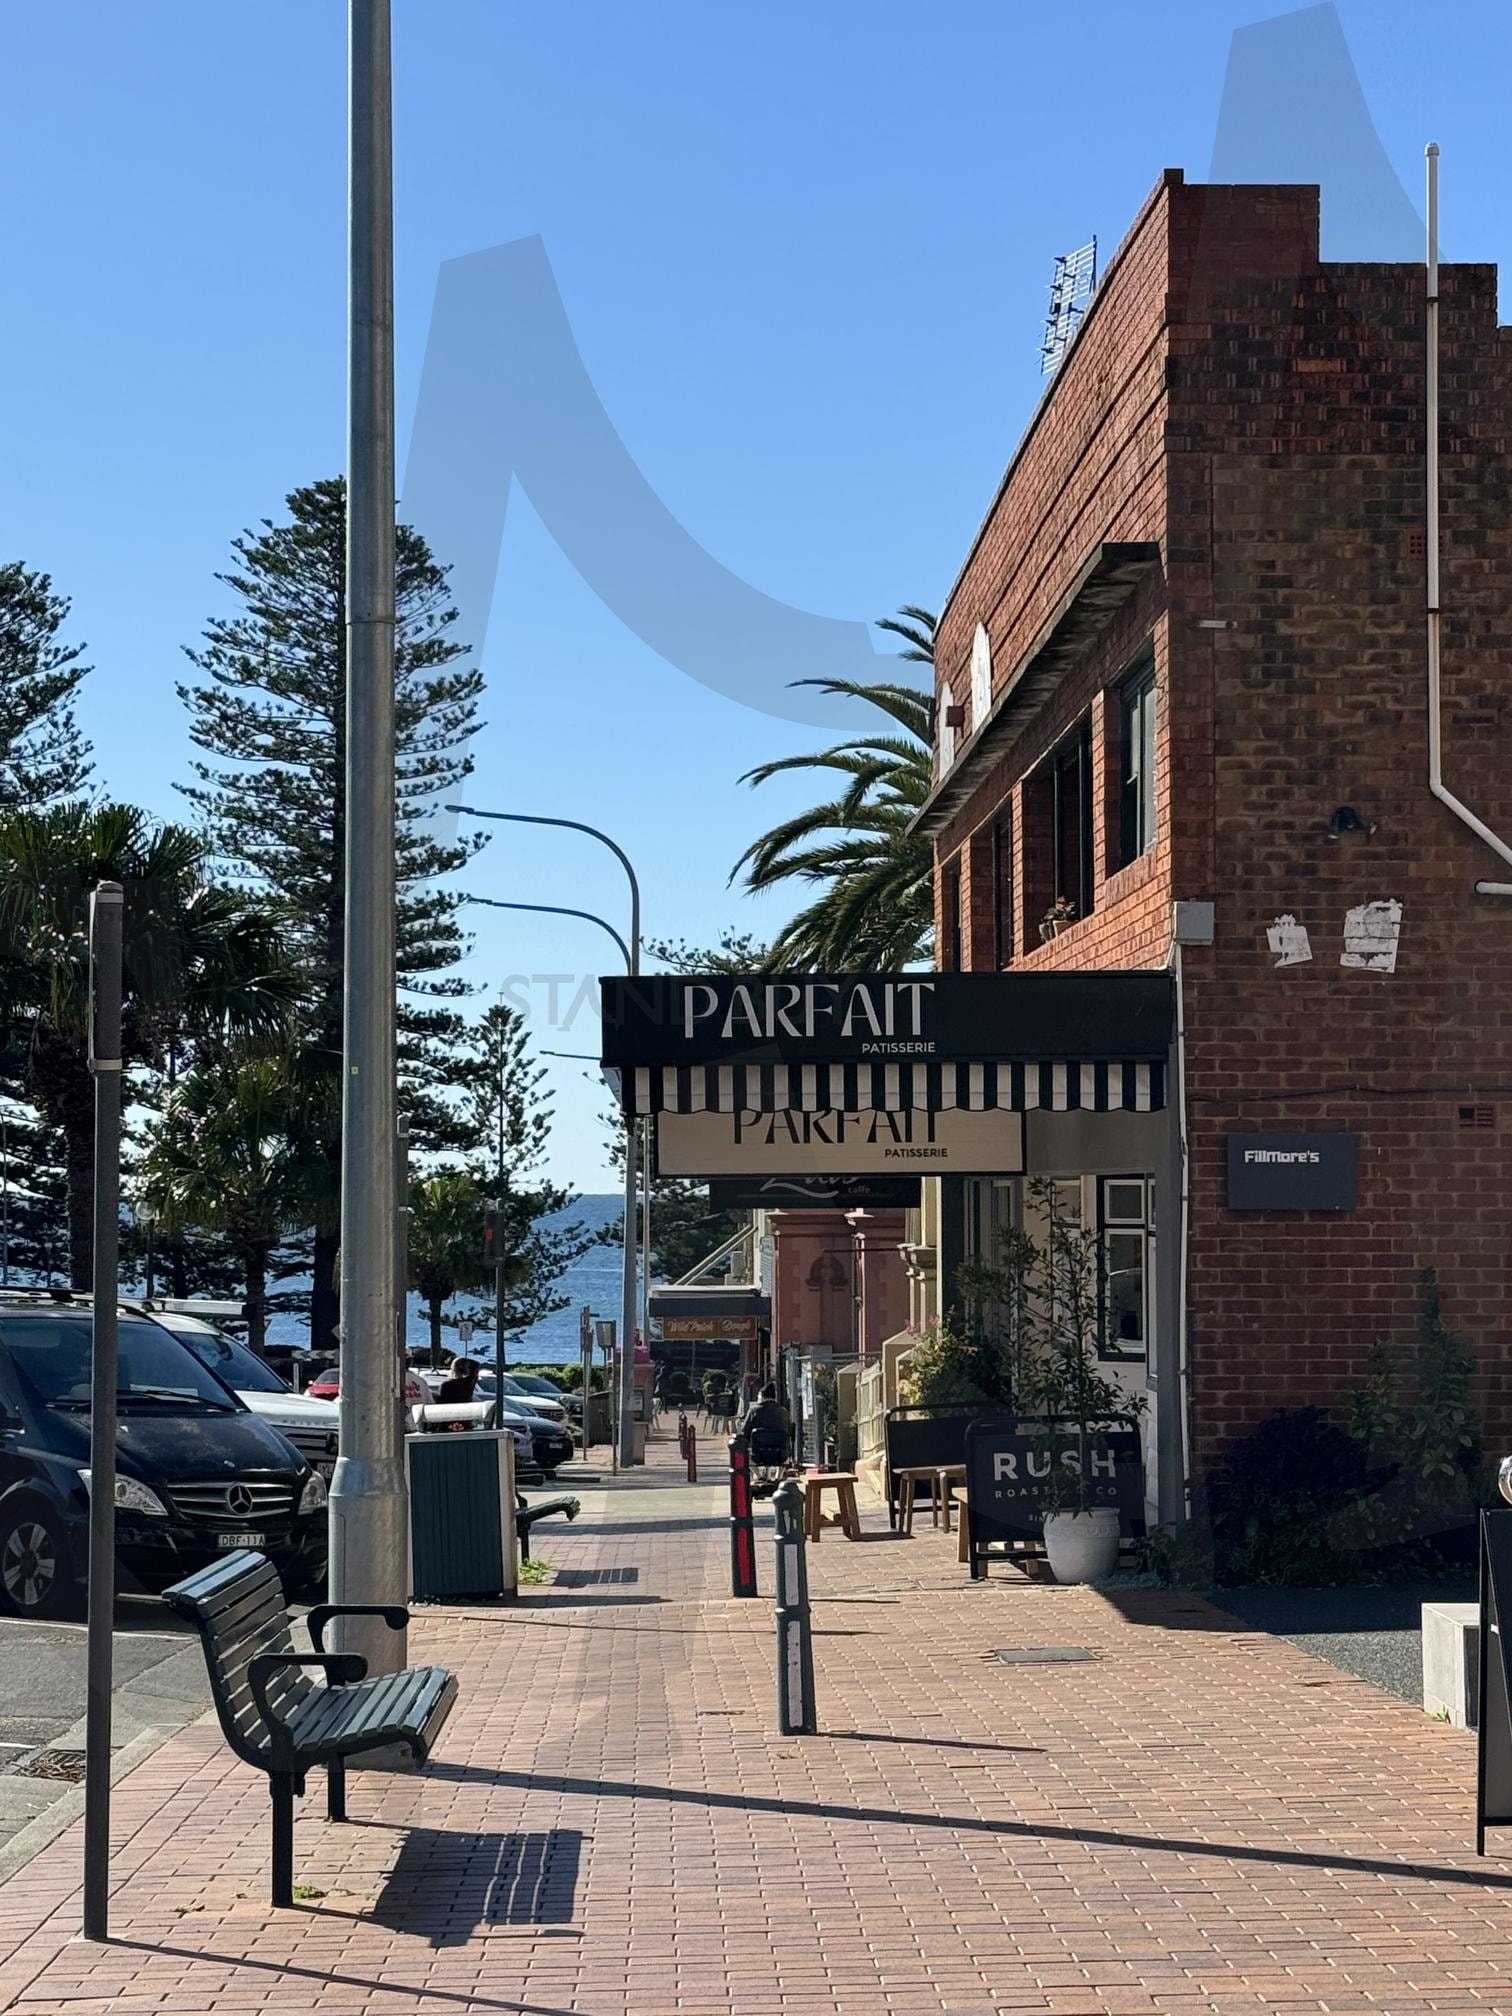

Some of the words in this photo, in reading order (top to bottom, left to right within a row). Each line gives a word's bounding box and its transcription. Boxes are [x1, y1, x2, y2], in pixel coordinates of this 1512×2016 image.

[683, 984, 935, 1039] PARFAIT
[862, 1042, 936, 1054] PATISSERIE
[884, 1148, 948, 1159] PATISSERIE
[993, 1449, 1116, 1481] RUSH
[1096, 1486, 1117, 1496] CO
